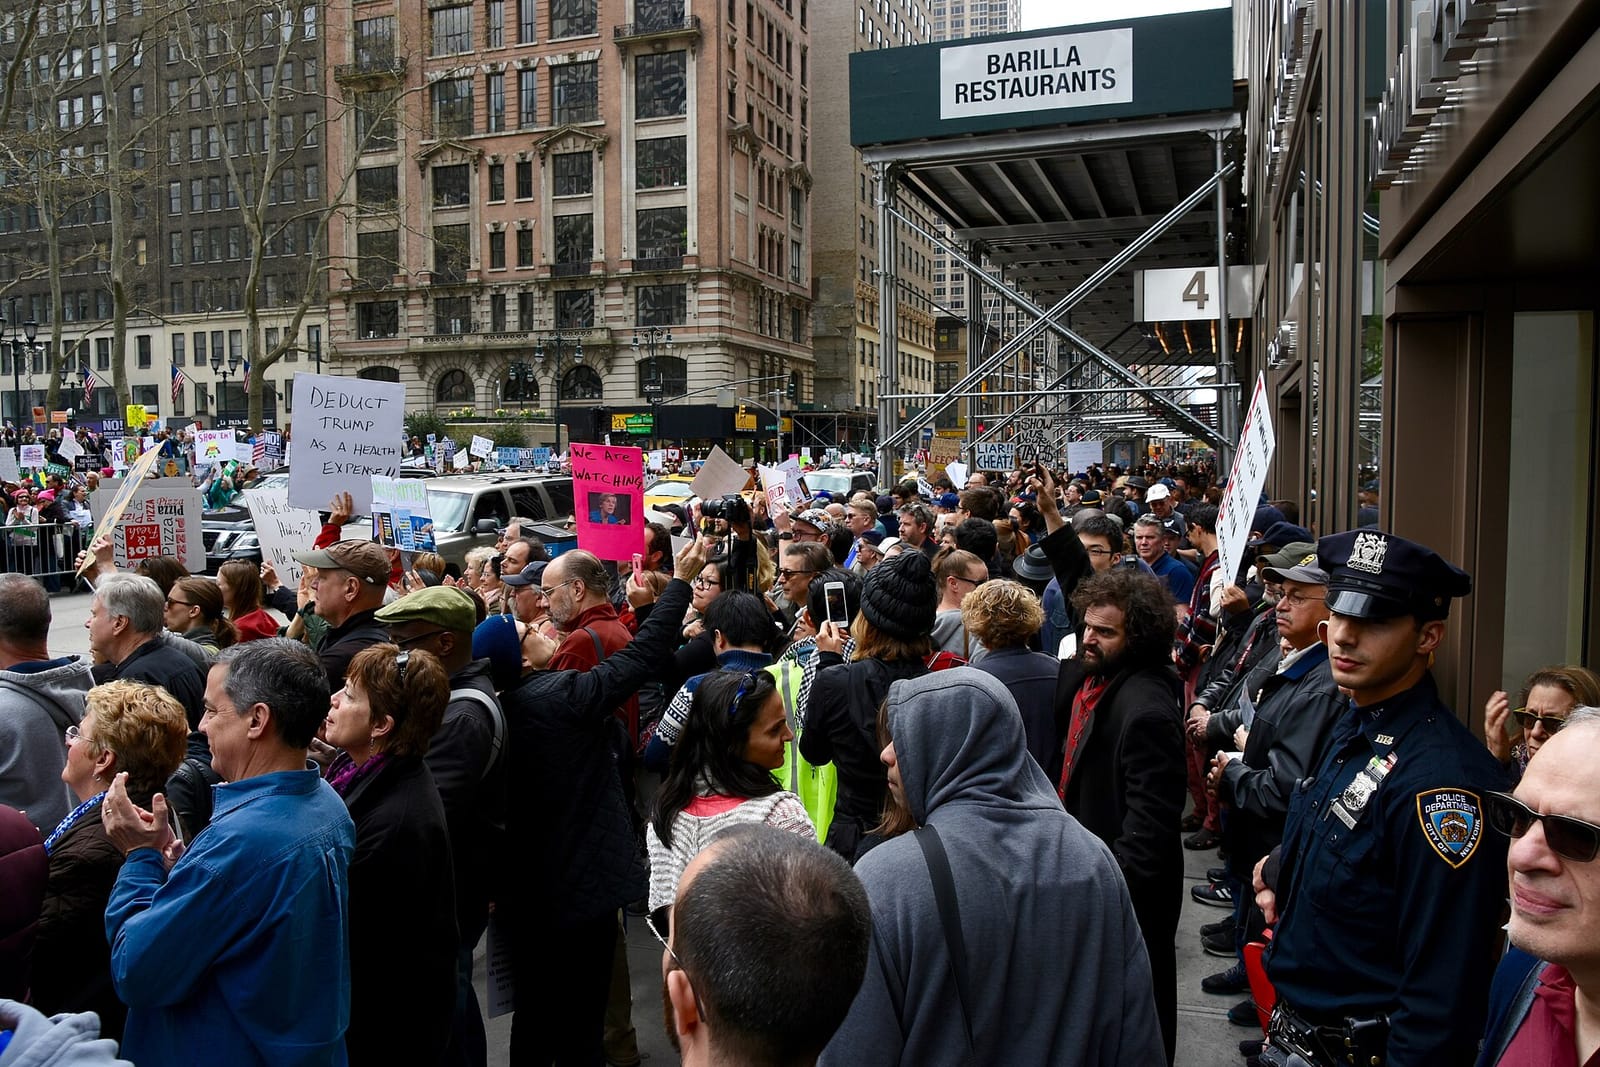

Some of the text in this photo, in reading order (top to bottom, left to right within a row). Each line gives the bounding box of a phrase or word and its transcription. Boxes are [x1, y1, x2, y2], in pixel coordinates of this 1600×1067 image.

[987, 46, 1081, 75] BARILLA
[955, 68, 1116, 104] RESTAURANTS
[1183, 271, 1209, 309] 4
[310, 386, 389, 410] DEDUCT
[103, 420, 124, 431] NO!
[318, 416, 374, 432] TRUMP
[1021, 417, 1053, 430] SHOW
[265, 432, 280, 445] NO!
[309, 438, 395, 456] AS A HEALTH
[519, 449, 534, 459] NO!
[976, 444, 1014, 454] LIAR!!
[976, 455, 1014, 469] CHEAT!
[146, 498, 155, 522] PIZZA
[120, 512, 144, 524] Pizz
[127, 526, 159, 540] Fresh
[162, 517, 175, 556] Pizza
[114, 525, 125, 568] PIZZA
[138, 536, 147, 546] &
[128, 545, 159, 557] Hot
[1435, 793, 1467, 803] POLICE
[1424, 801, 1477, 814] DEPARTMENT
[1425, 822, 1449, 854] CITY OF
[1460, 819, 1481, 858] NEW YORK
